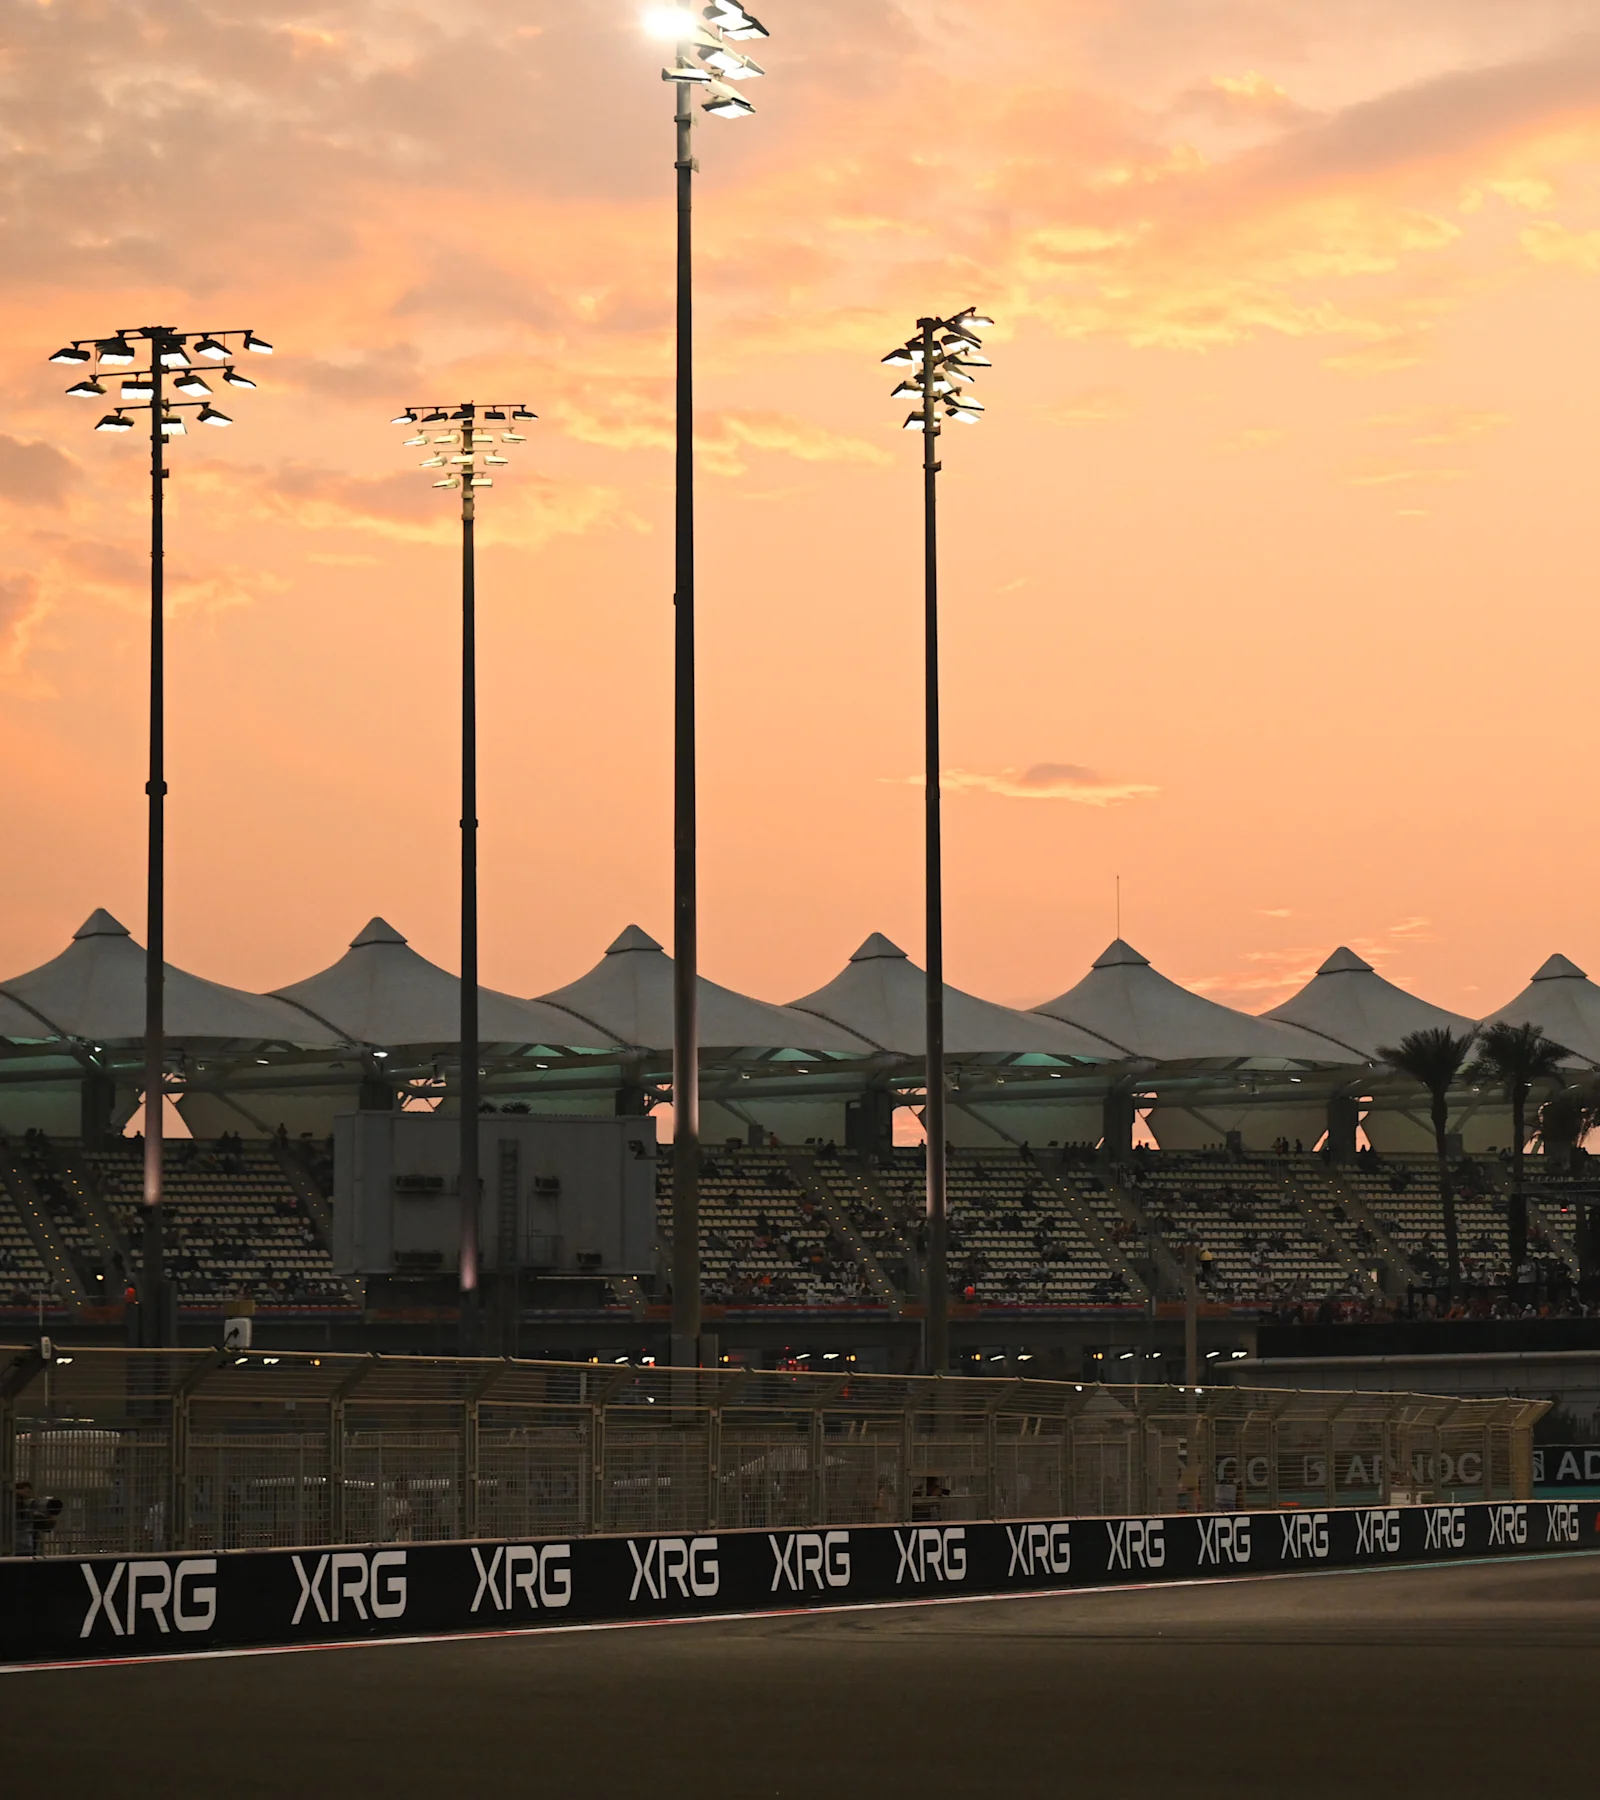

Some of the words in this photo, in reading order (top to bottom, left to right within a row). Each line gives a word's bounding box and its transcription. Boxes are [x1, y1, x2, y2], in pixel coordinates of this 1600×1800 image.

[1106, 1520, 1165, 1571] XRG
[1198, 1517, 1251, 1565] XRG
[1280, 1514, 1329, 1560] XRG
[1355, 1511, 1400, 1555] XRG
[1424, 1508, 1466, 1550] XRG
[1488, 1506, 1527, 1546] XRG
[1547, 1505, 1579, 1542] XRG
[628, 1537, 719, 1601] XRG
[768, 1531, 851, 1592] XRG
[894, 1527, 967, 1584] XRG
[1006, 1524, 1070, 1577] XRG
[79, 1559, 217, 1638] XRG
[291, 1551, 407, 1625] XRG
[471, 1545, 572, 1612] XRG
